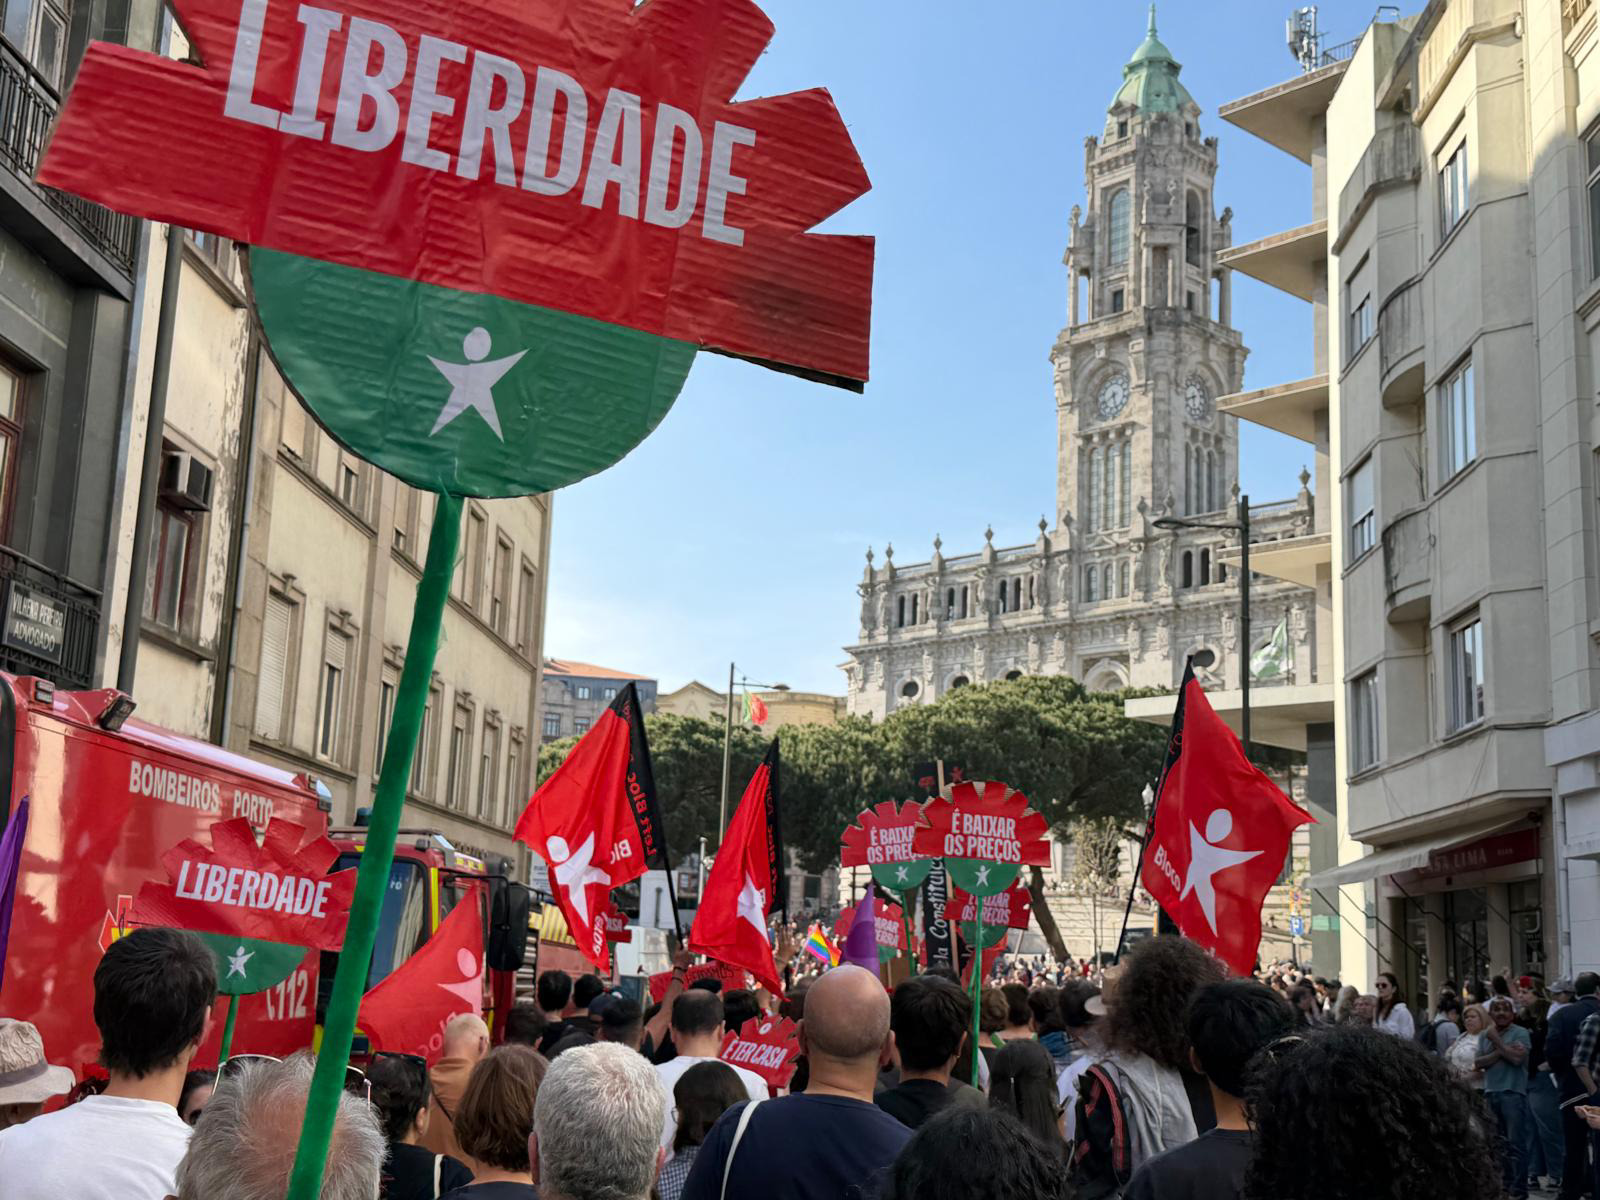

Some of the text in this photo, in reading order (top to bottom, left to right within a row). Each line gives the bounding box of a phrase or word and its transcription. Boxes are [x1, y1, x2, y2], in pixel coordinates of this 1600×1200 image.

[223, 0, 757, 247] LIBERDADE
[13, 621, 56, 652] ADVOGADO
[129, 760, 220, 813] BOMBEIROS
[870, 826, 915, 847] É BAIXA
[952, 808, 1016, 840] É BAIXAR
[867, 846, 883, 864] OS
[944, 833, 1022, 864] OS PREÇOS
[1154, 843, 1181, 892] Bloco
[176, 860, 332, 918] LIBERDADE
[276, 970, 308, 1020] 112
[750, 1043, 788, 1069] CASA
